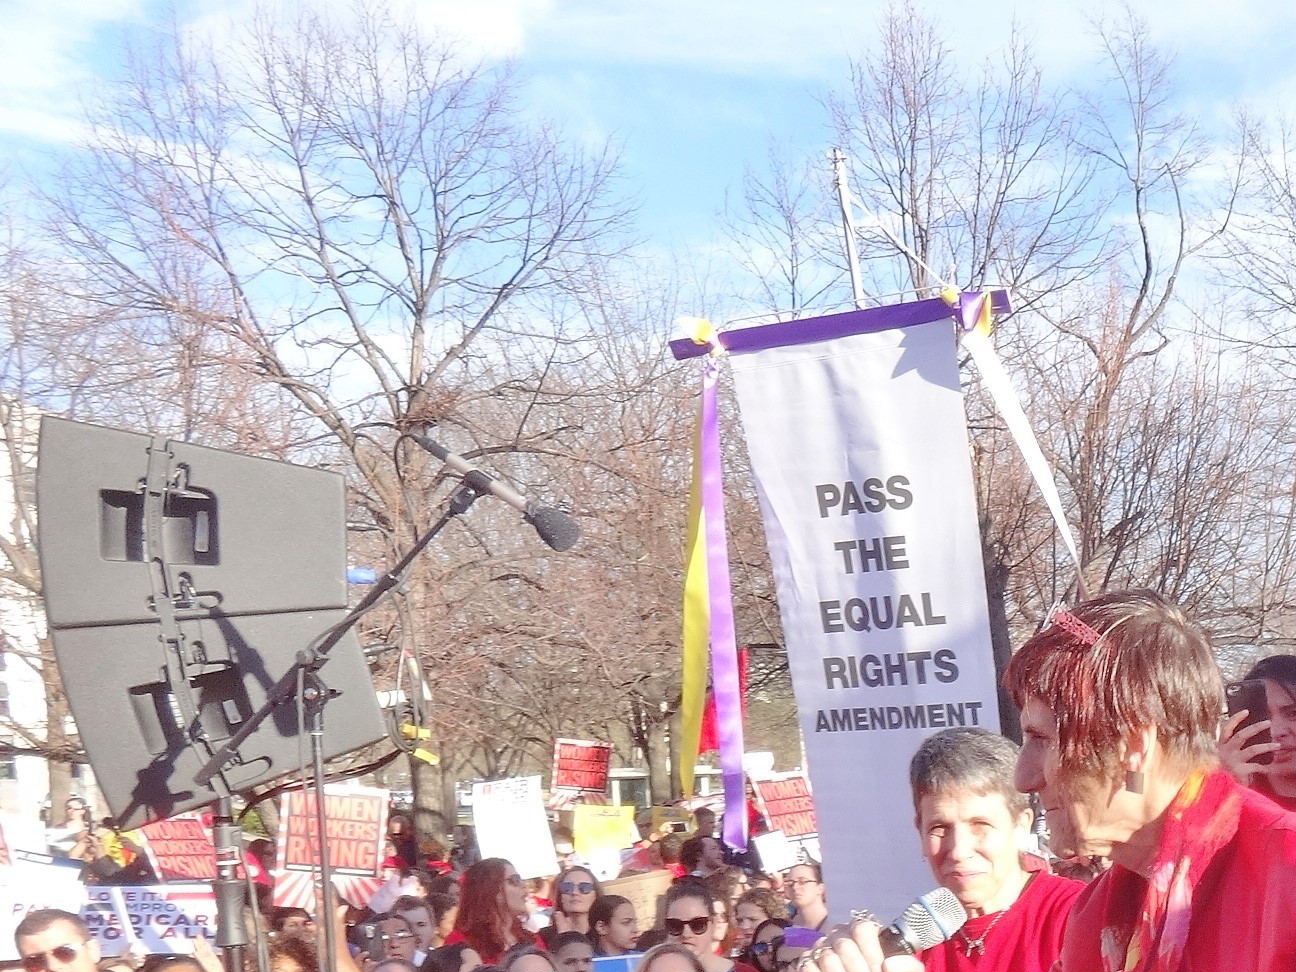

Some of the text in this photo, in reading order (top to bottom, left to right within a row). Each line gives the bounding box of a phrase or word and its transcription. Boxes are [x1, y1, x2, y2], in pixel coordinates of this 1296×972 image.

[815, 475, 914, 518] PASS
[834, 535, 910, 575] THE
[819, 592, 947, 634] EQUAL
[822, 649, 960, 690] RIGHTS
[815, 702, 983, 733] AMENDMENT
[291, 792, 378, 822] WMEN
[88, 892, 136, 901] LOE
